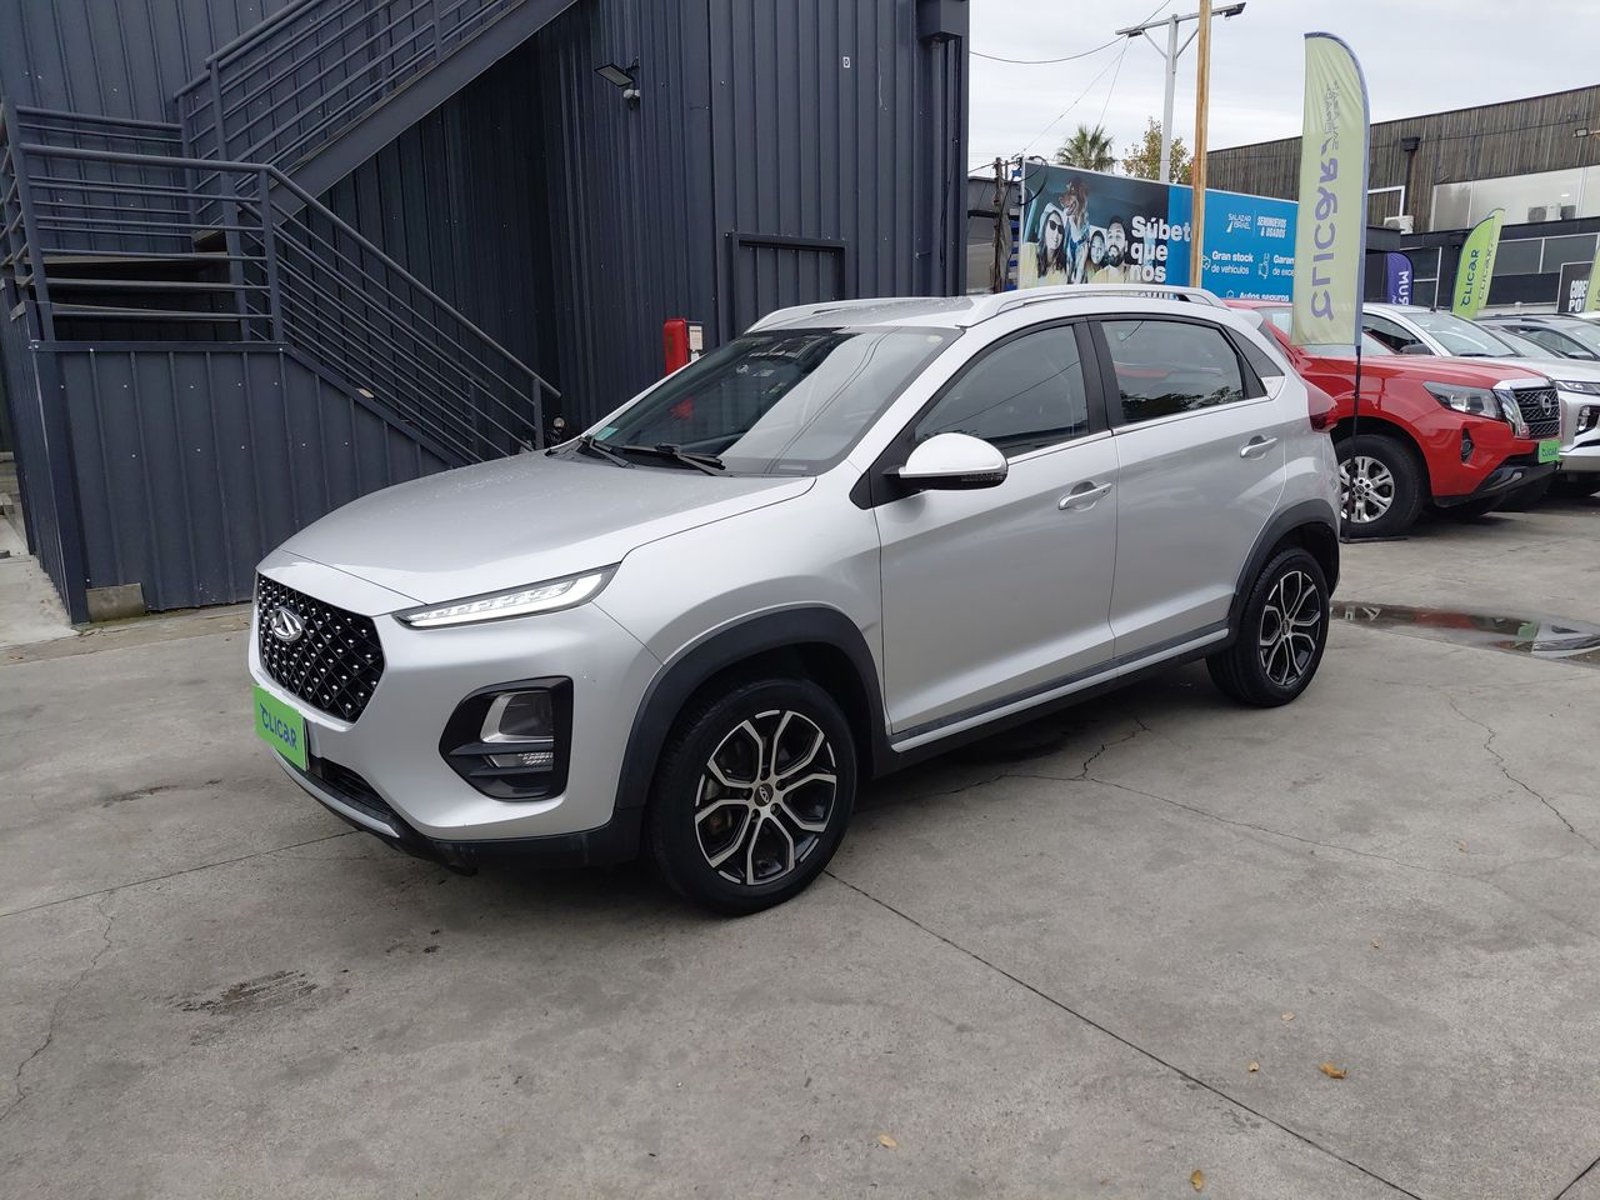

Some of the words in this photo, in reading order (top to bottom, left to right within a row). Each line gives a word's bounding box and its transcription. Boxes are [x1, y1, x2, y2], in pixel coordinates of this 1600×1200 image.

[1131, 215, 1192, 242] Súbet
[1130, 242, 1168, 264] que
[1212, 250, 1231, 261] Gran
[1232, 252, 1254, 263] stock
[1273, 254, 1295, 265] Garan
[1129, 264, 1167, 283] nos
[1211, 264, 1220, 274] de
[1460, 249, 1480, 307] CLICAR
[260, 702, 297, 750] CLICAR
